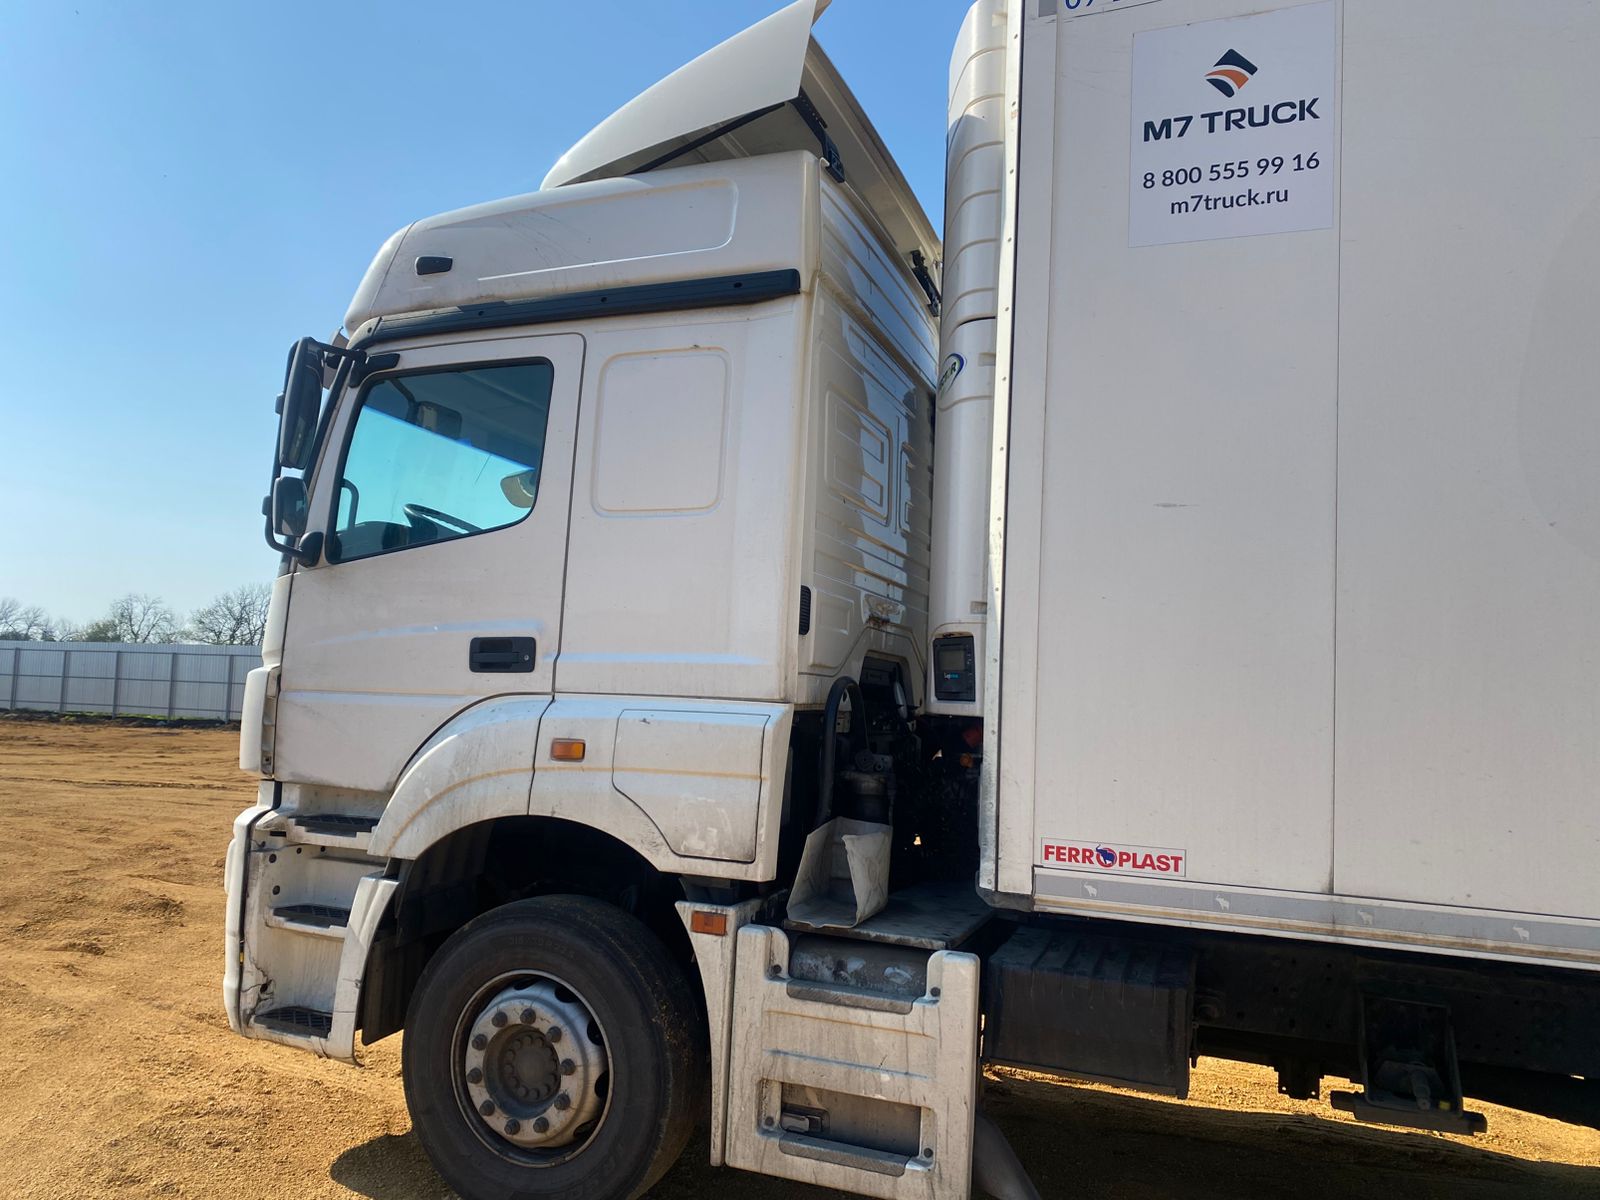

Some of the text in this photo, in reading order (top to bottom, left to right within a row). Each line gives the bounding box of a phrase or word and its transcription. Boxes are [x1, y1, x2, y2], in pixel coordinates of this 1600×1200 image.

[1143, 97, 1320, 142] M7 TRUCK
[1142, 151, 1321, 189] 8 800 555 99 16
[1170, 187, 1289, 215] m7truck.ru
[1044, 844, 1183, 873] FERROPLAST
